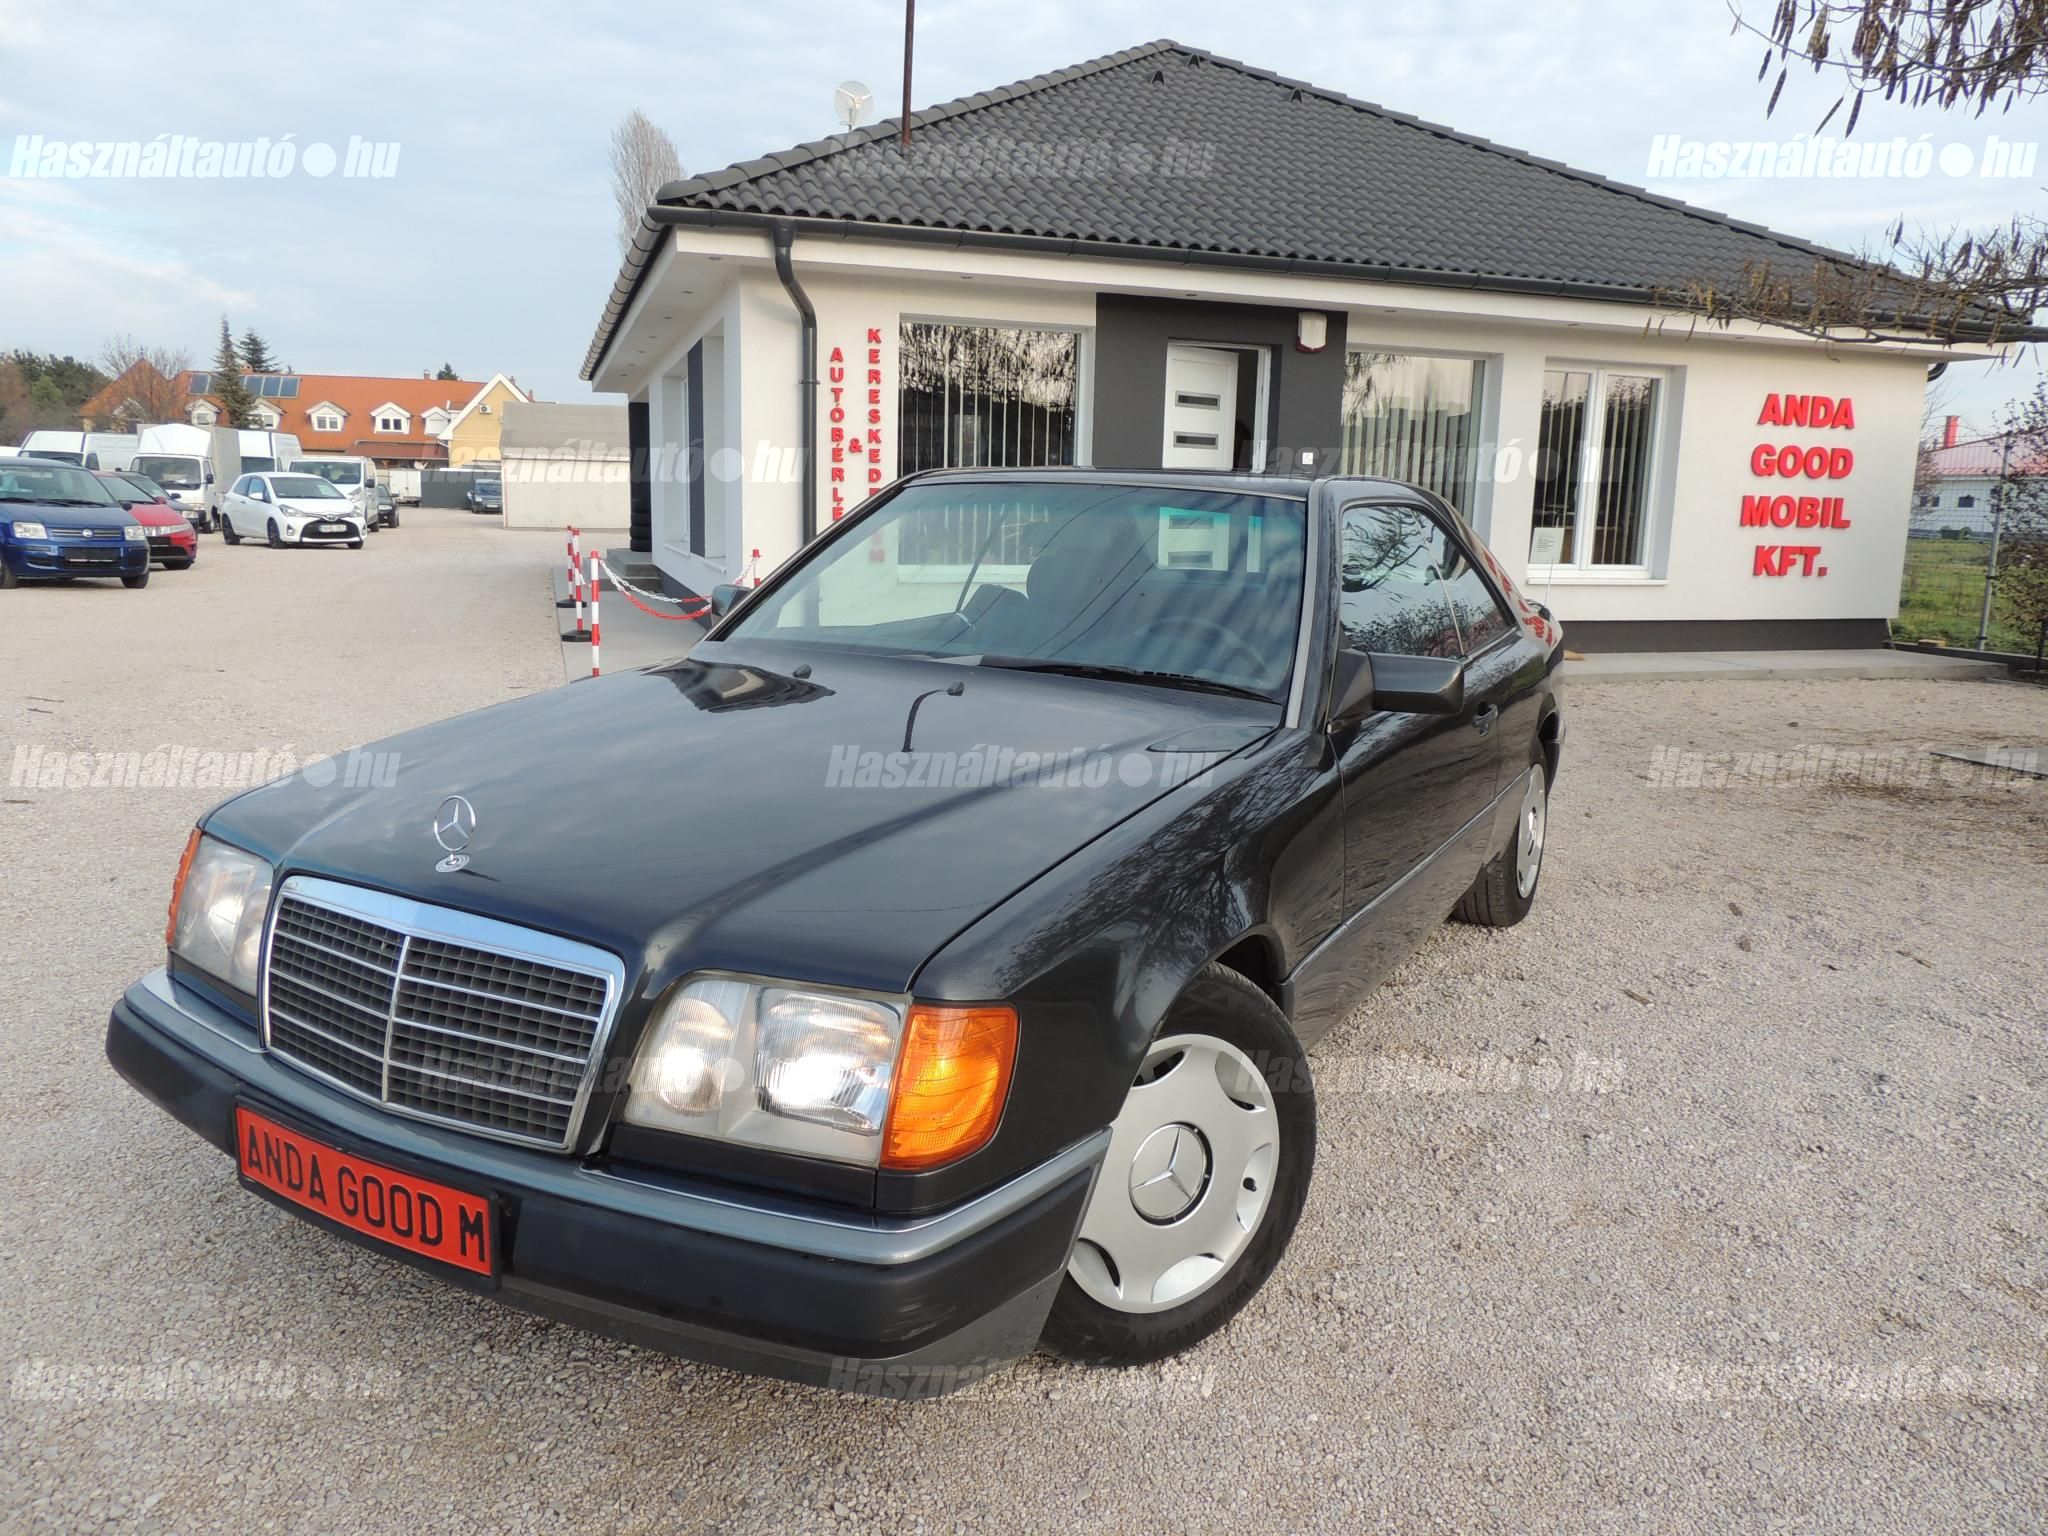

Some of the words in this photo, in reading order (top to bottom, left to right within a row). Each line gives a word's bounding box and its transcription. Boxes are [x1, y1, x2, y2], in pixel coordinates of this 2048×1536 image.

[1757, 393, 1856, 430] ANDA
[829, 346, 846, 522] AUTÓBÉRLÉ
[848, 437, 863, 453] &
[1750, 443, 1854, 480] GOOD
[1739, 495, 1852, 530] MOBIL
[1752, 545, 1829, 577] KFT.
[248, 1123, 328, 1206] ANDA
[337, 1164, 443, 1247] GOOD
[458, 1202, 486, 1263] M
